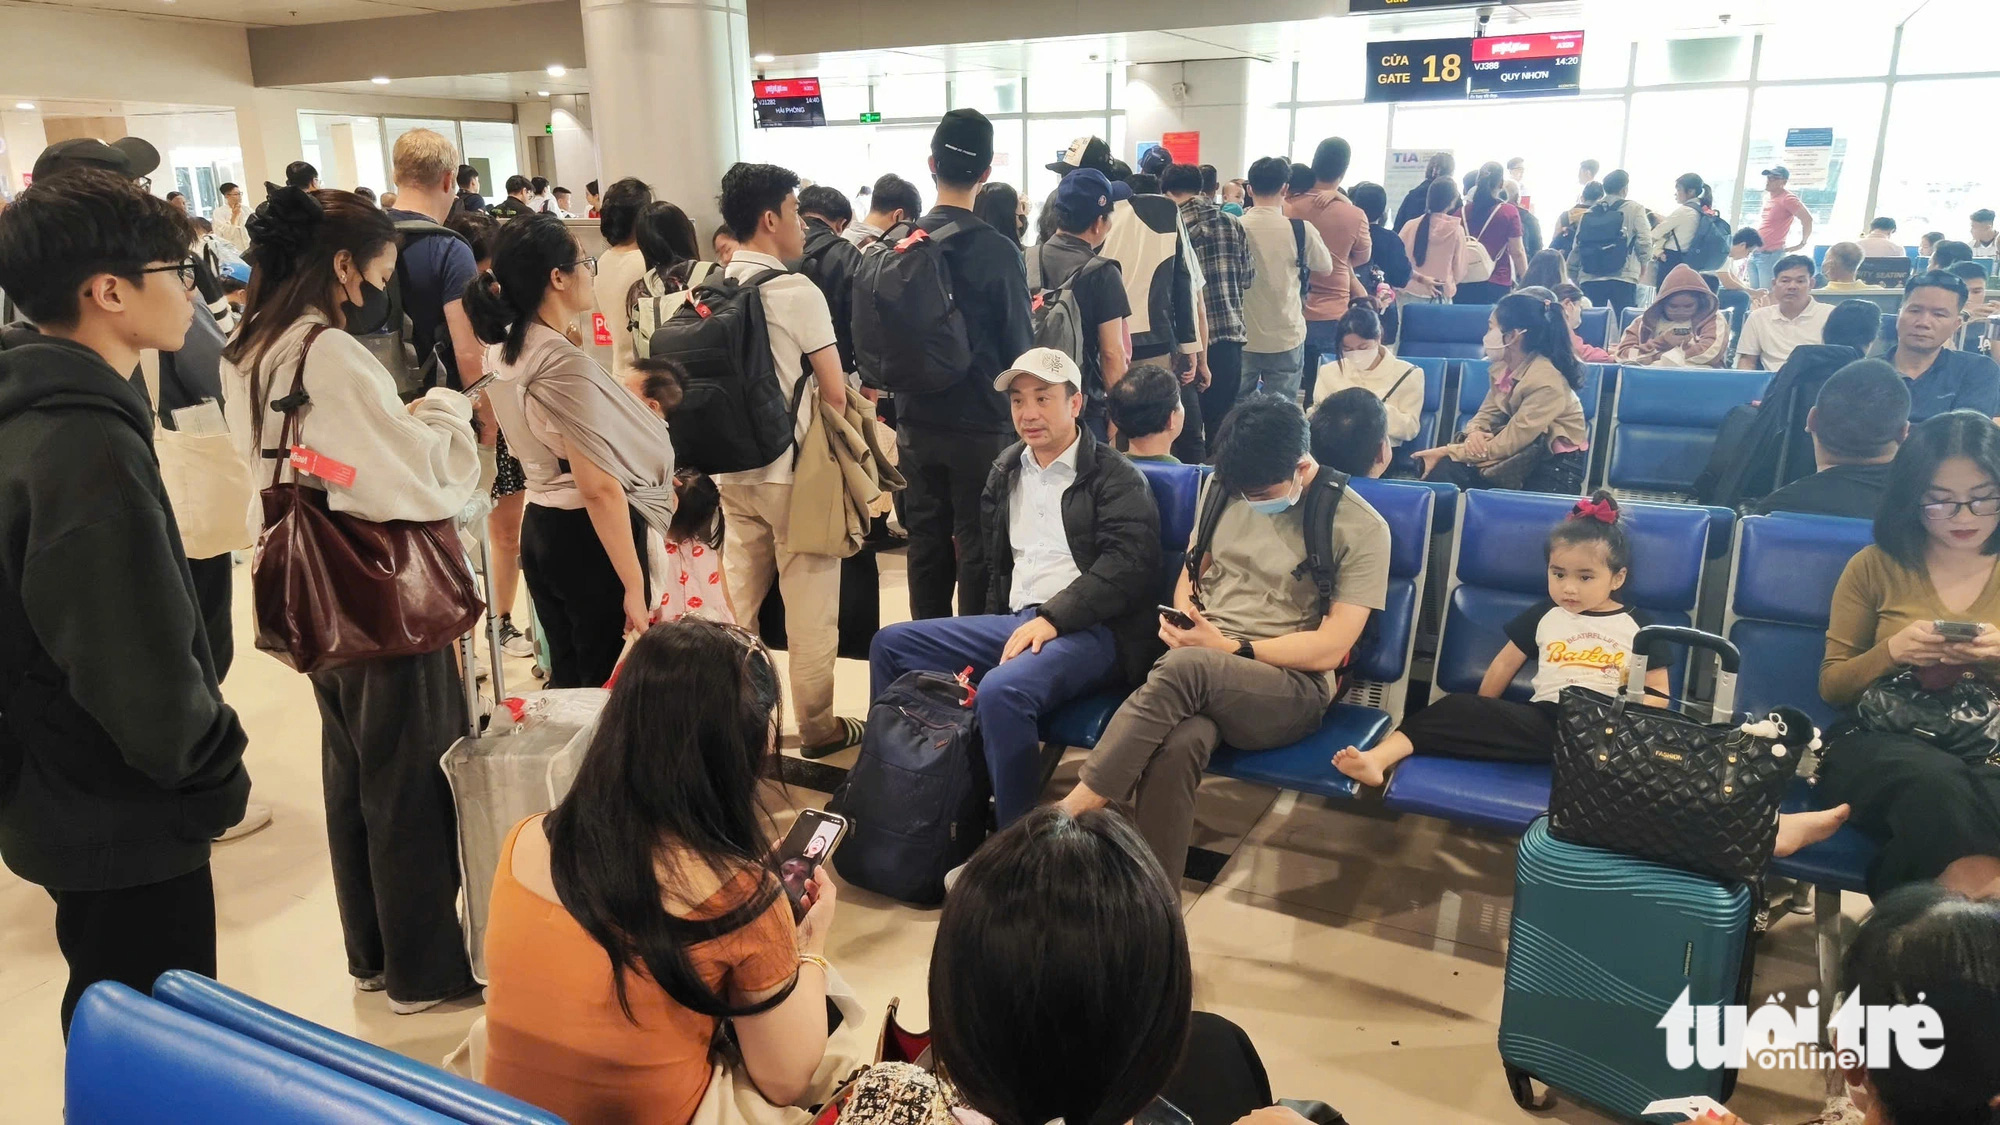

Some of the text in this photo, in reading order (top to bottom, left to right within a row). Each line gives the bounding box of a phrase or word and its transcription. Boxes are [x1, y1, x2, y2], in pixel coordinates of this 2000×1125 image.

[1381, 53, 1409, 67] CỬA
[1555, 57, 1579, 66] 14:20
[1421, 54, 1461, 83] 18
[1474, 62, 1500, 71] VJ388
[1378, 73, 1411, 85] GATE
[1500, 70, 1550, 83] QUY NHƠN
[1393, 152, 1419, 163] TIA
[1603, 635, 1619, 650] LIFE
